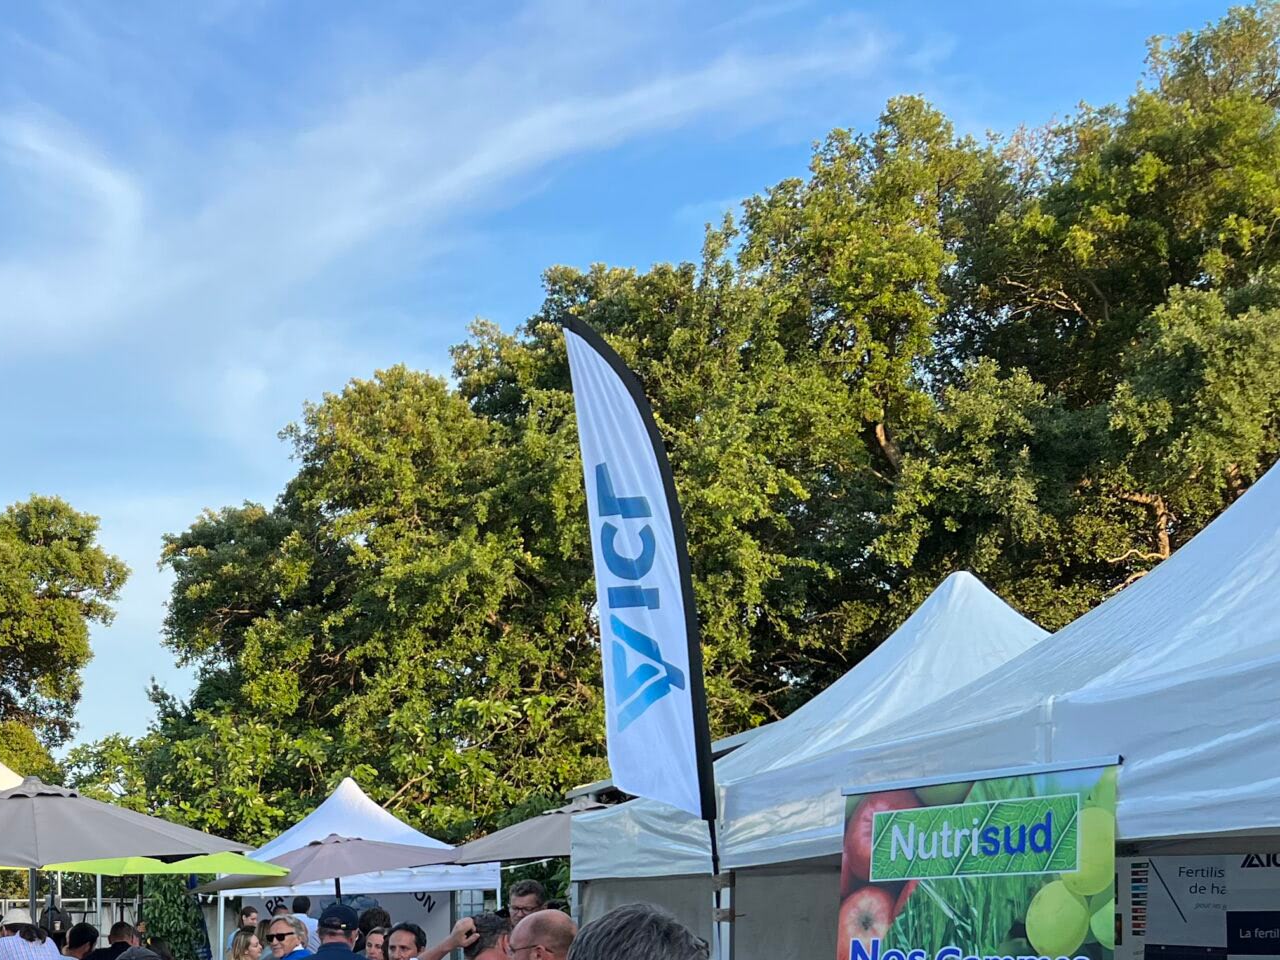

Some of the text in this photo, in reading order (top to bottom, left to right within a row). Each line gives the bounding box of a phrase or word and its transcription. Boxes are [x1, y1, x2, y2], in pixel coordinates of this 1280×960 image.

[890, 809, 1053, 862] Nutrisud
[1189, 883, 1207, 895] de
[1239, 928, 1252, 938] La
